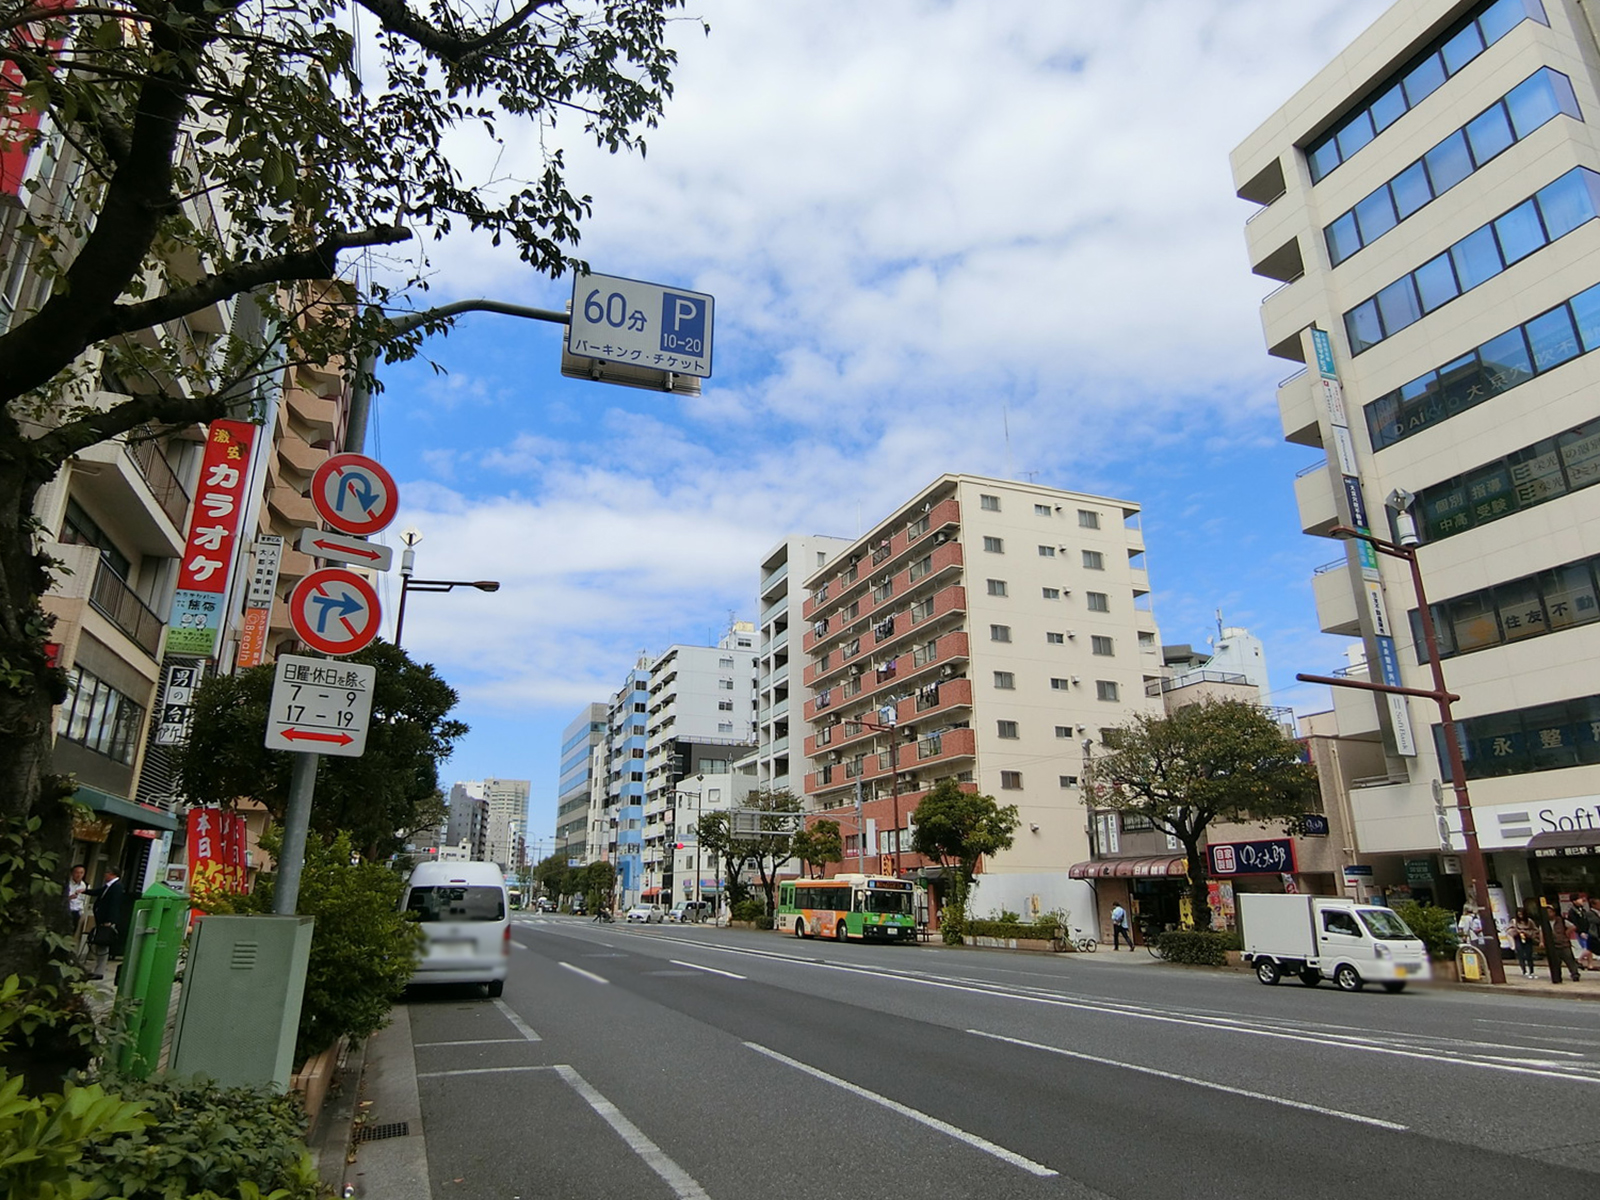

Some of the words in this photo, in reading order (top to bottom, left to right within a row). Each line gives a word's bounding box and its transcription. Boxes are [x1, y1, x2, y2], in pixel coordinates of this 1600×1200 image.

[584, 288, 648, 333] 60分
[674, 299, 697, 331] P
[663, 333, 702, 353] 10-20
[188, 463, 240, 582] カラオケ
[240, 625, 256, 662] Breath
[284, 663, 367, 688] 日曜・休日を除く
